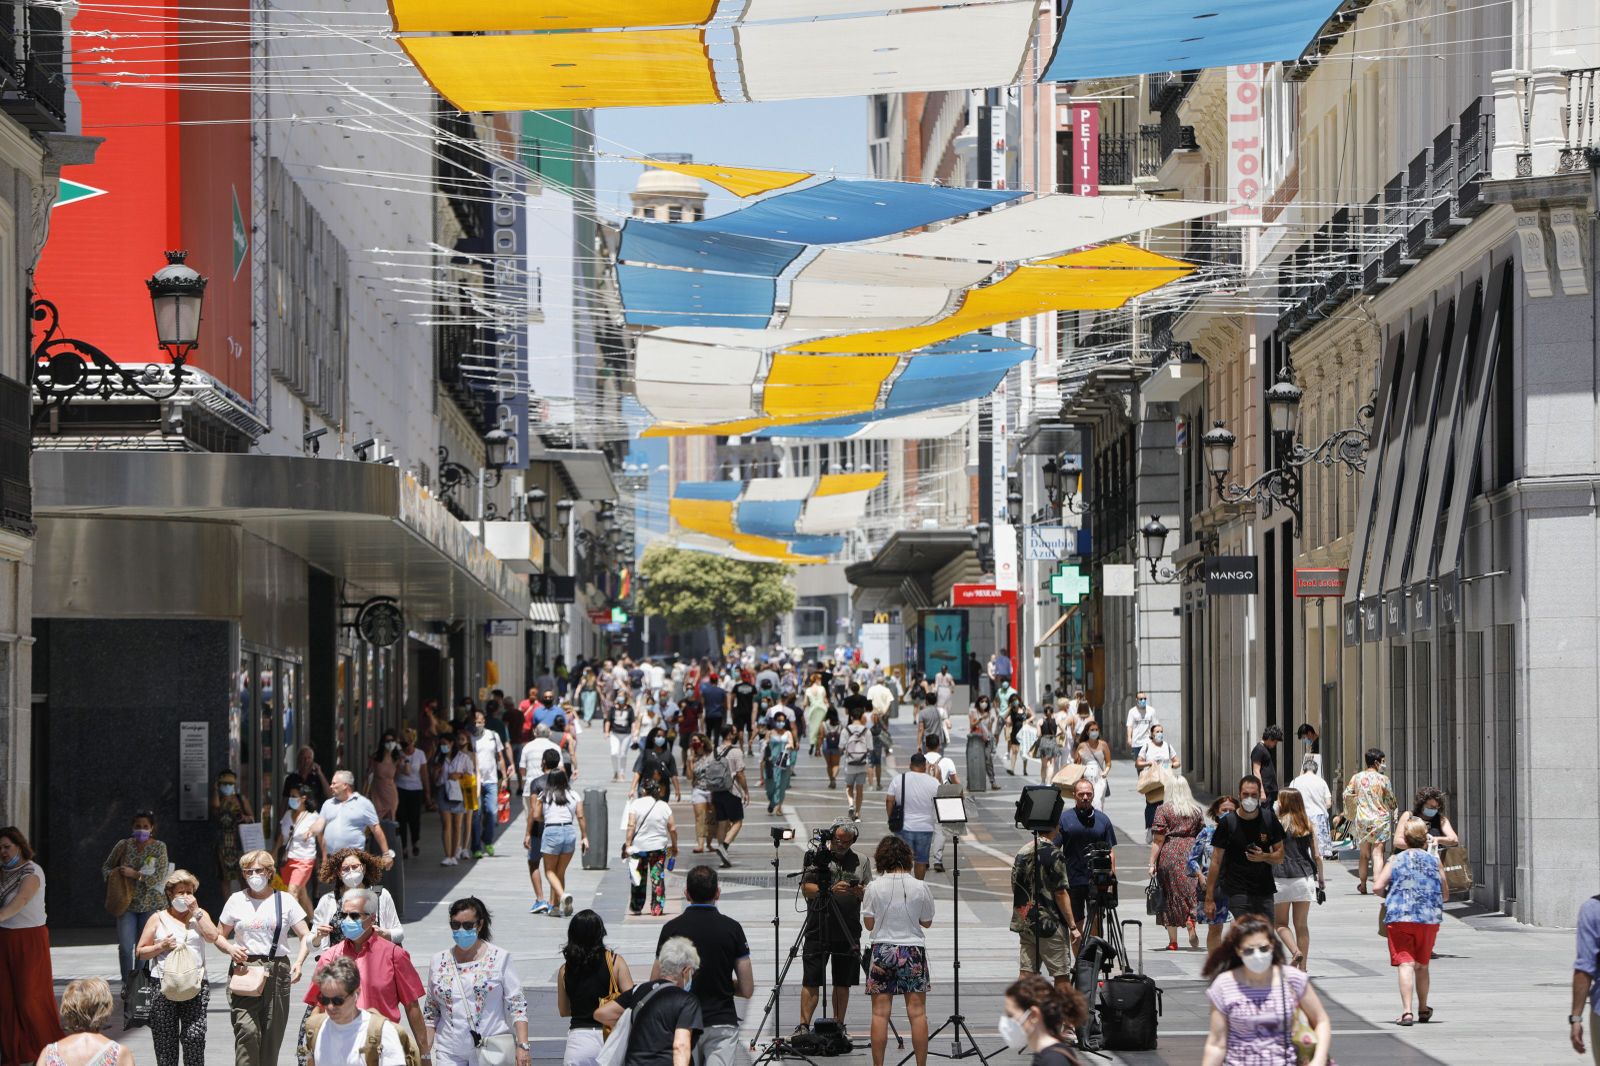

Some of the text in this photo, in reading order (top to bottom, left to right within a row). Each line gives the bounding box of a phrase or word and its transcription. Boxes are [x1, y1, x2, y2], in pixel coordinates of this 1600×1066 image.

[1080, 109, 1091, 179] PETIT
[493, 167, 517, 285] 2000
[1031, 538, 1074, 549] Danubio
[1031, 549, 1056, 558] Azul
[1210, 571, 1254, 580] MANGO
